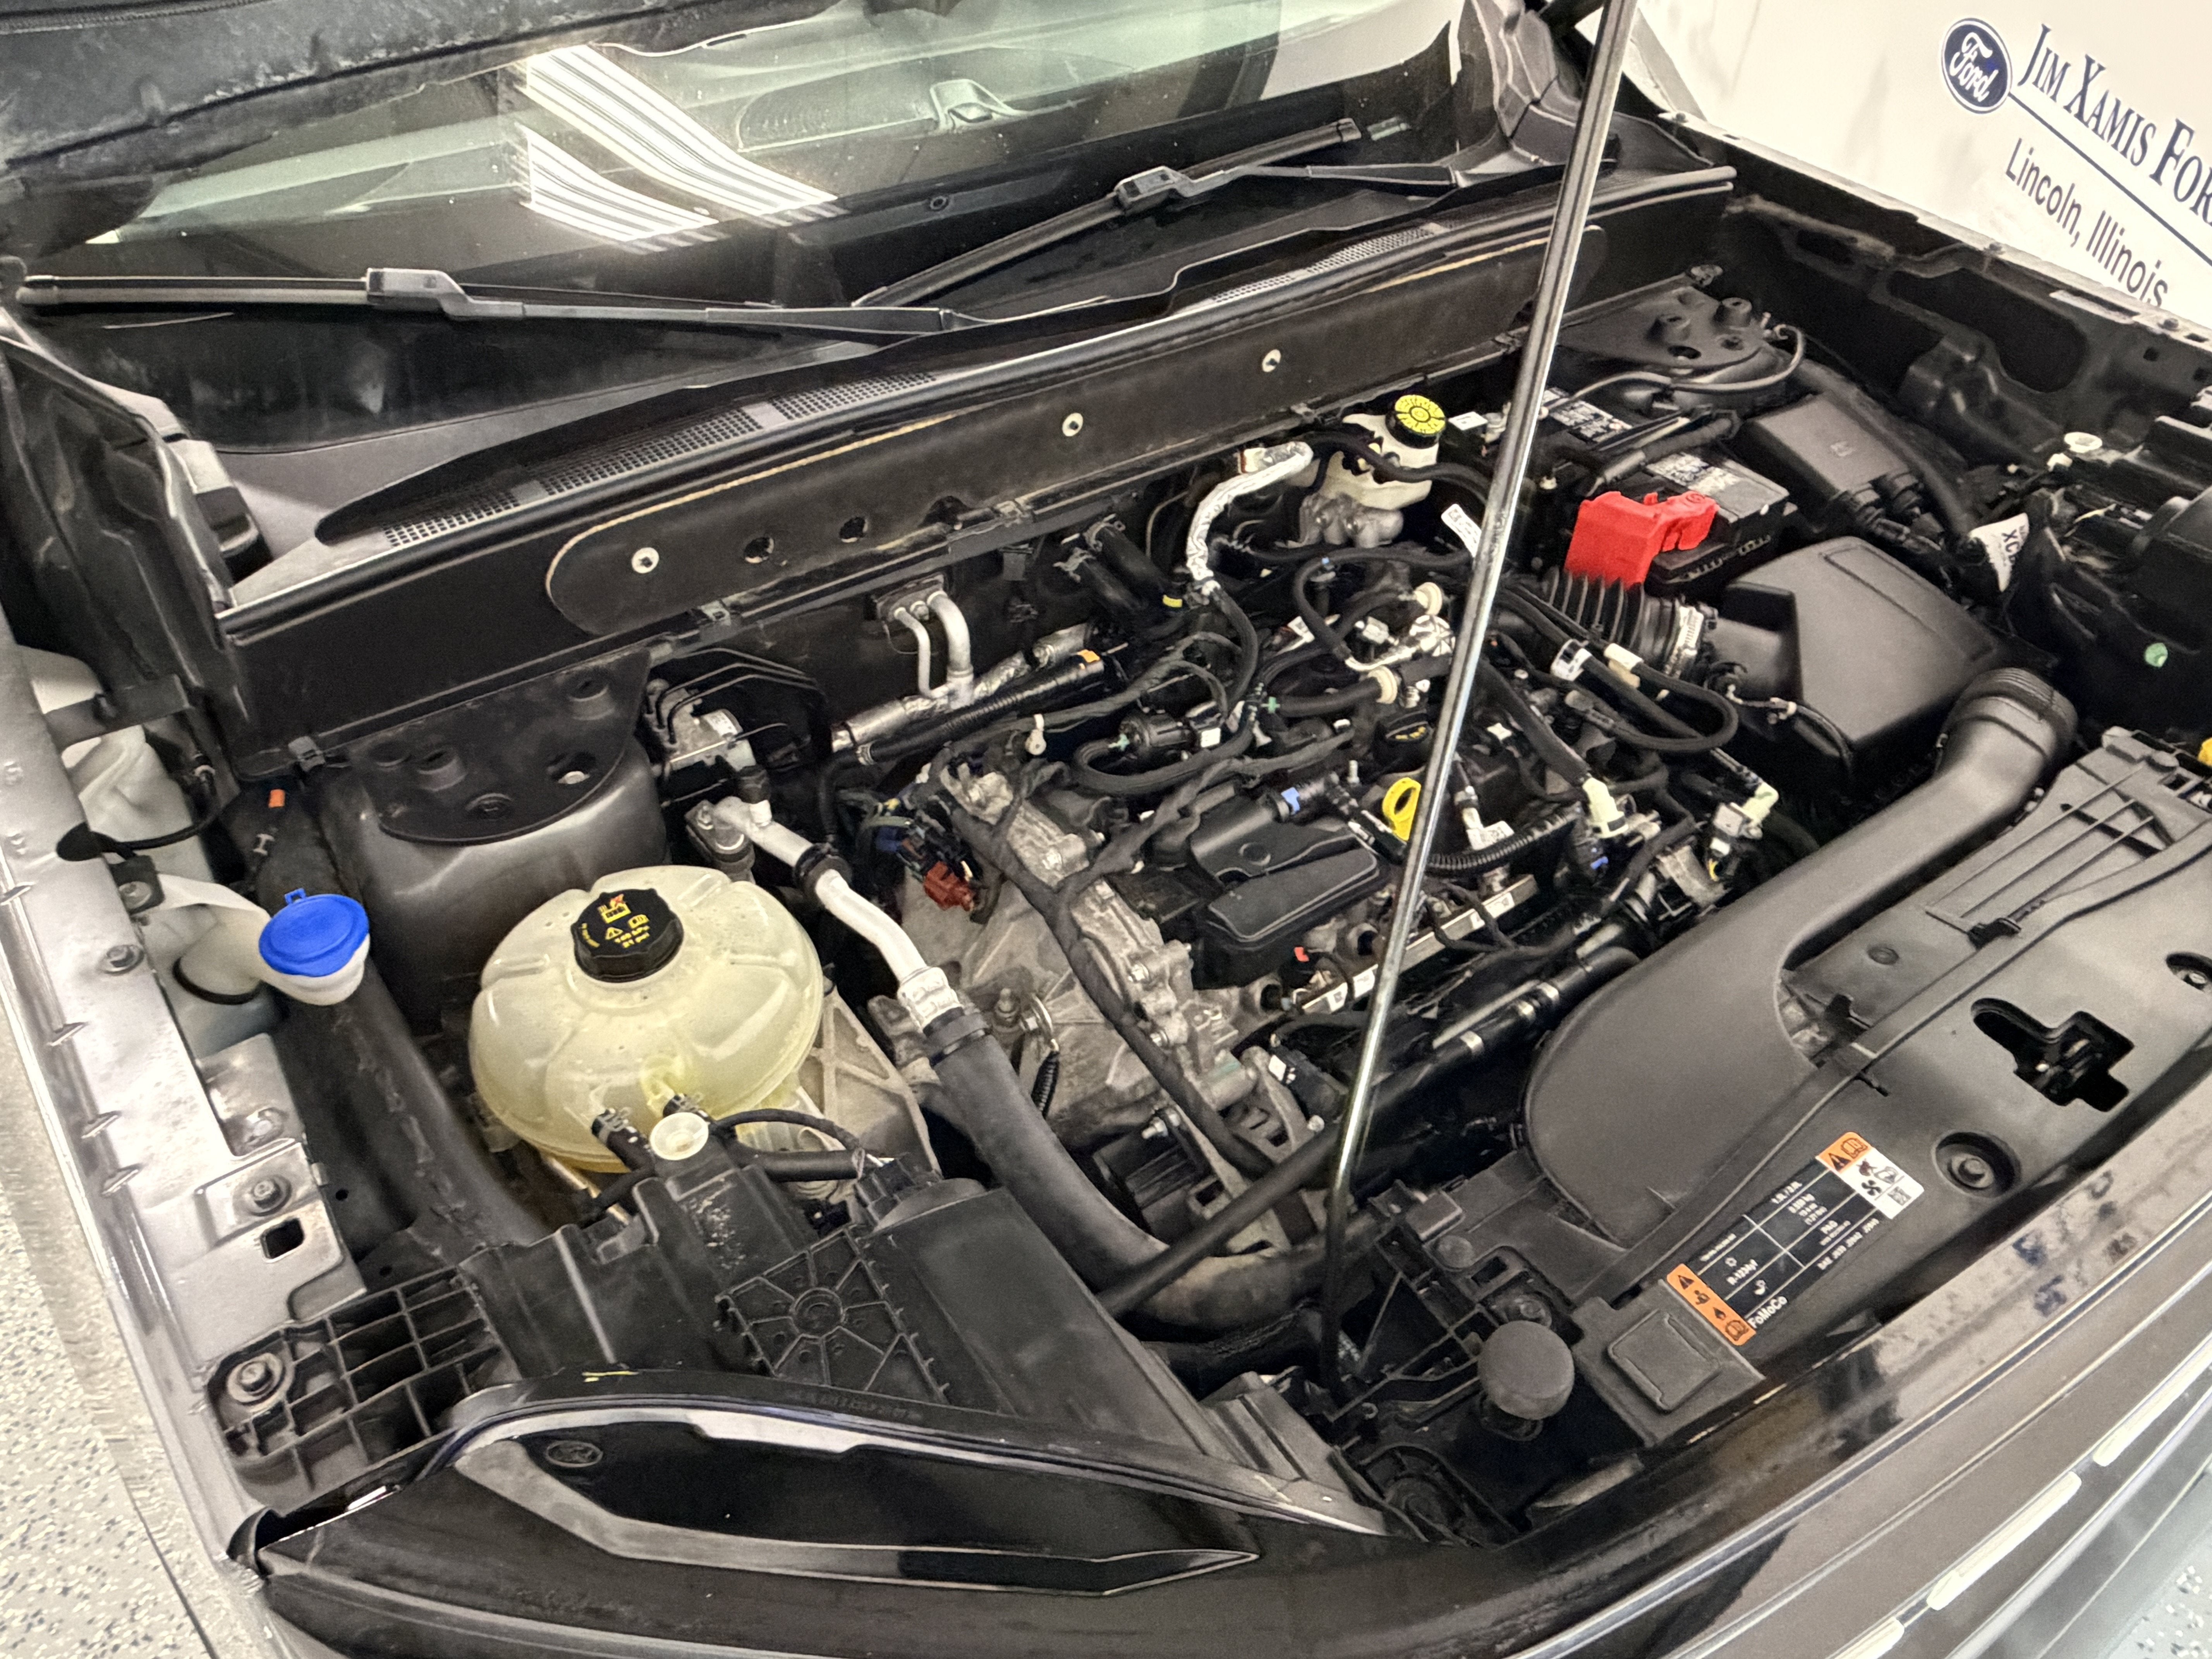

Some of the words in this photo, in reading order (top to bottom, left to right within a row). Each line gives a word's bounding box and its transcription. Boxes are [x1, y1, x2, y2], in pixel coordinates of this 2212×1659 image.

[1949, 32, 1999, 102] Ford
[2006, 137, 2081, 248] Lincoln,
[2086, 210, 2168, 307] Illinois
[1747, 1296, 1788, 1328] FoMoCo
